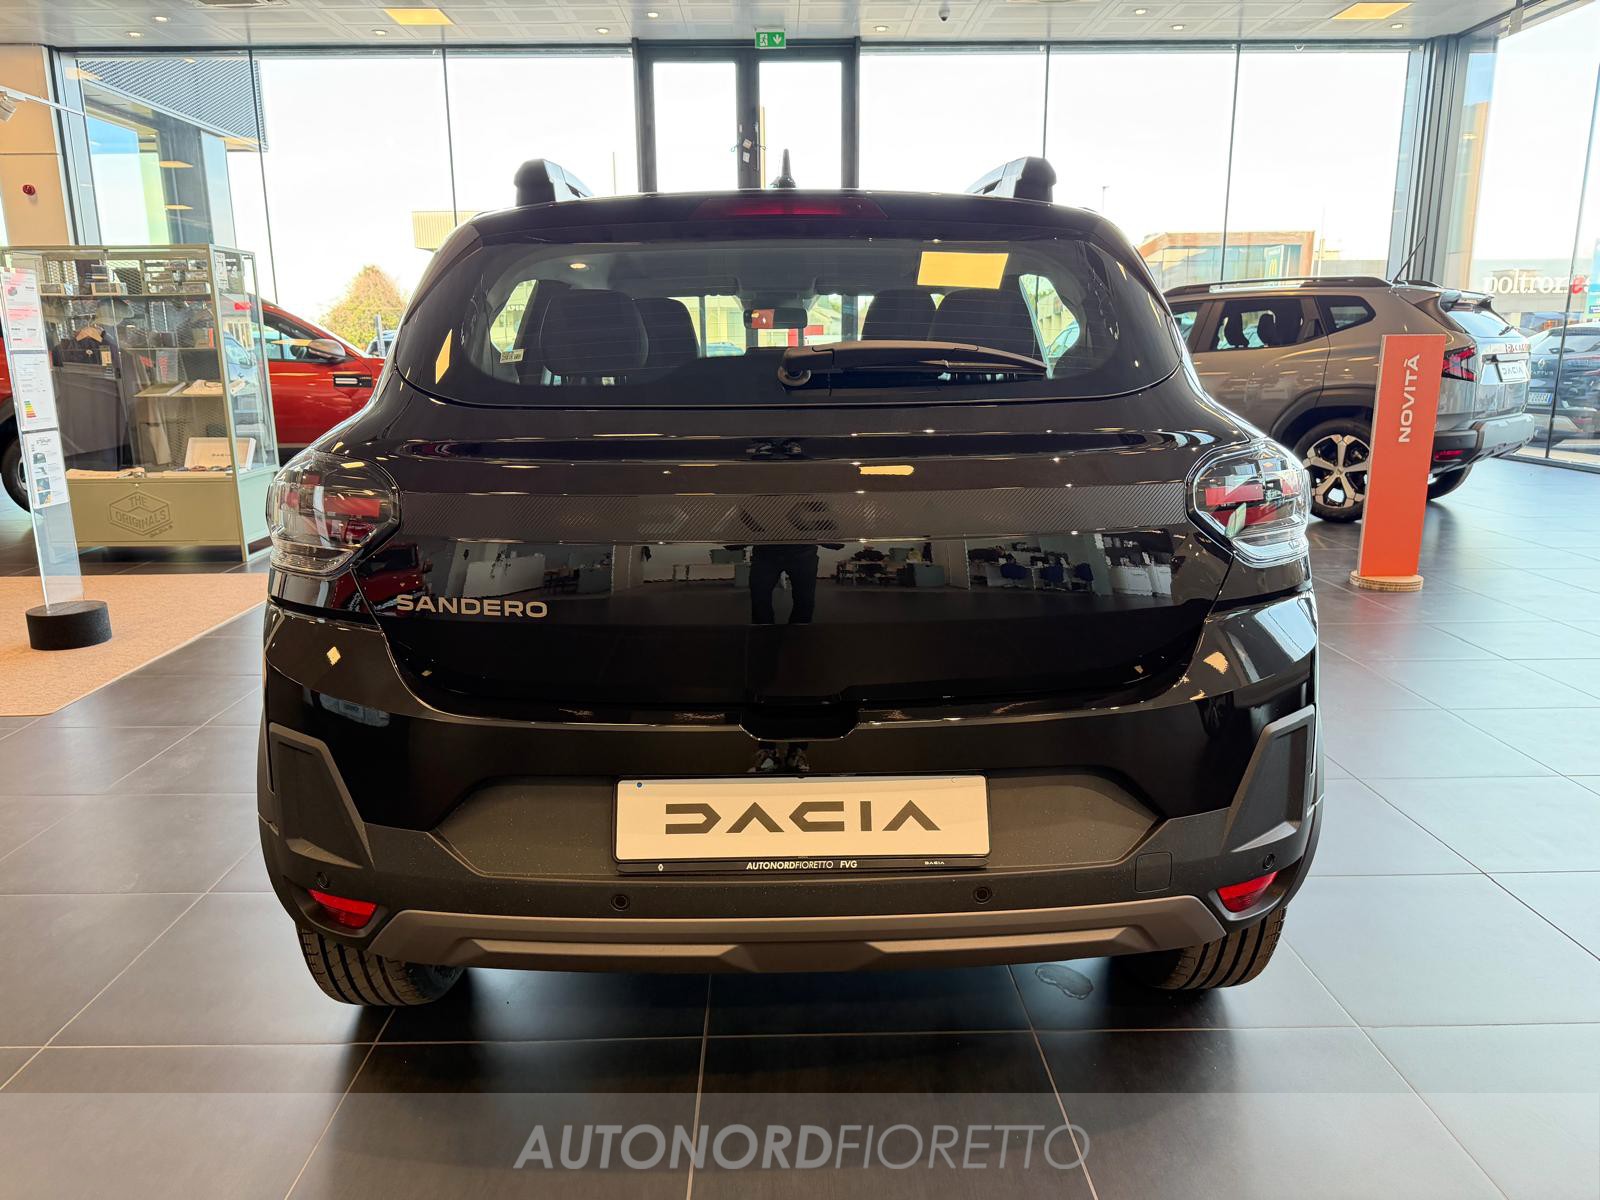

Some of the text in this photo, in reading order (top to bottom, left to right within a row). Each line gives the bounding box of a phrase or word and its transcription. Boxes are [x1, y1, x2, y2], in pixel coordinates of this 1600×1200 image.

[1398, 354, 1420, 443] NOVITÀ
[128, 496, 148, 508] THE
[115, 510, 167, 530] ORIGINALS
[396, 594, 548, 618] SANDERO
[665, 799, 941, 835] DACIA
[746, 859, 858, 870] AUTONORDFIORETTO FVG
